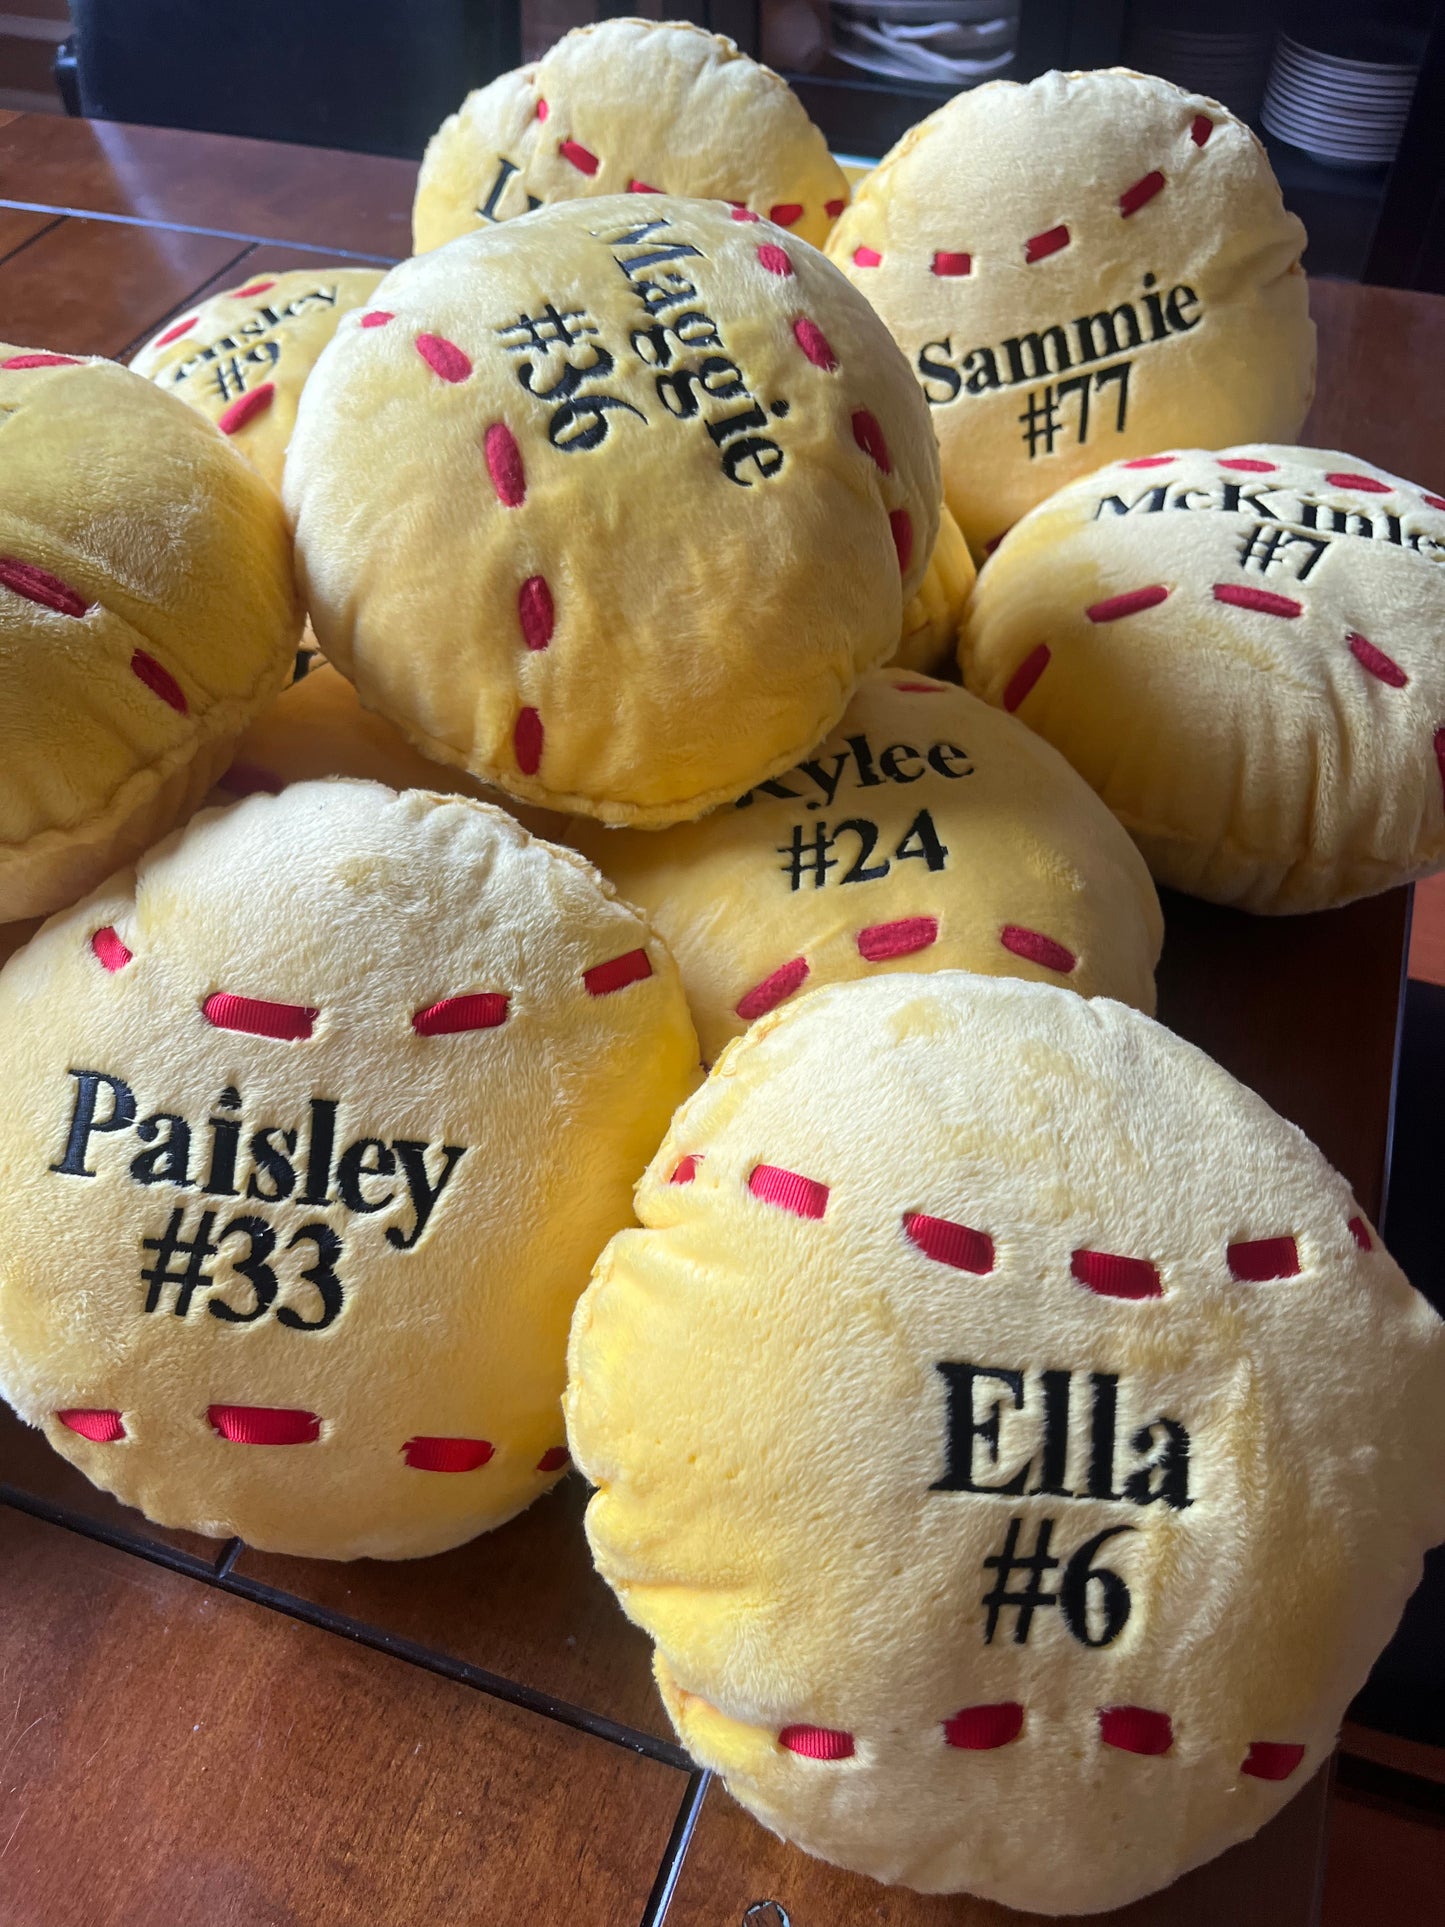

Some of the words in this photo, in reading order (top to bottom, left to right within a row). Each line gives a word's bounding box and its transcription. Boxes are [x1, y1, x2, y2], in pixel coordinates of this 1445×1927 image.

[497, 303, 649, 453] #36
[588, 218, 790, 487] Maggie
[918, 272, 1203, 404] Sammie
[1019, 361, 1133, 459] #77
[1096, 483, 1445, 557] McKinle
[1238, 525, 1332, 581] #7
[777, 808, 949, 892] #24
[49, 1069, 467, 1250] Paisley
[140, 1207, 344, 1332] #33
[927, 1361, 1195, 1512] Ella
[982, 1518, 1140, 1649] #6
